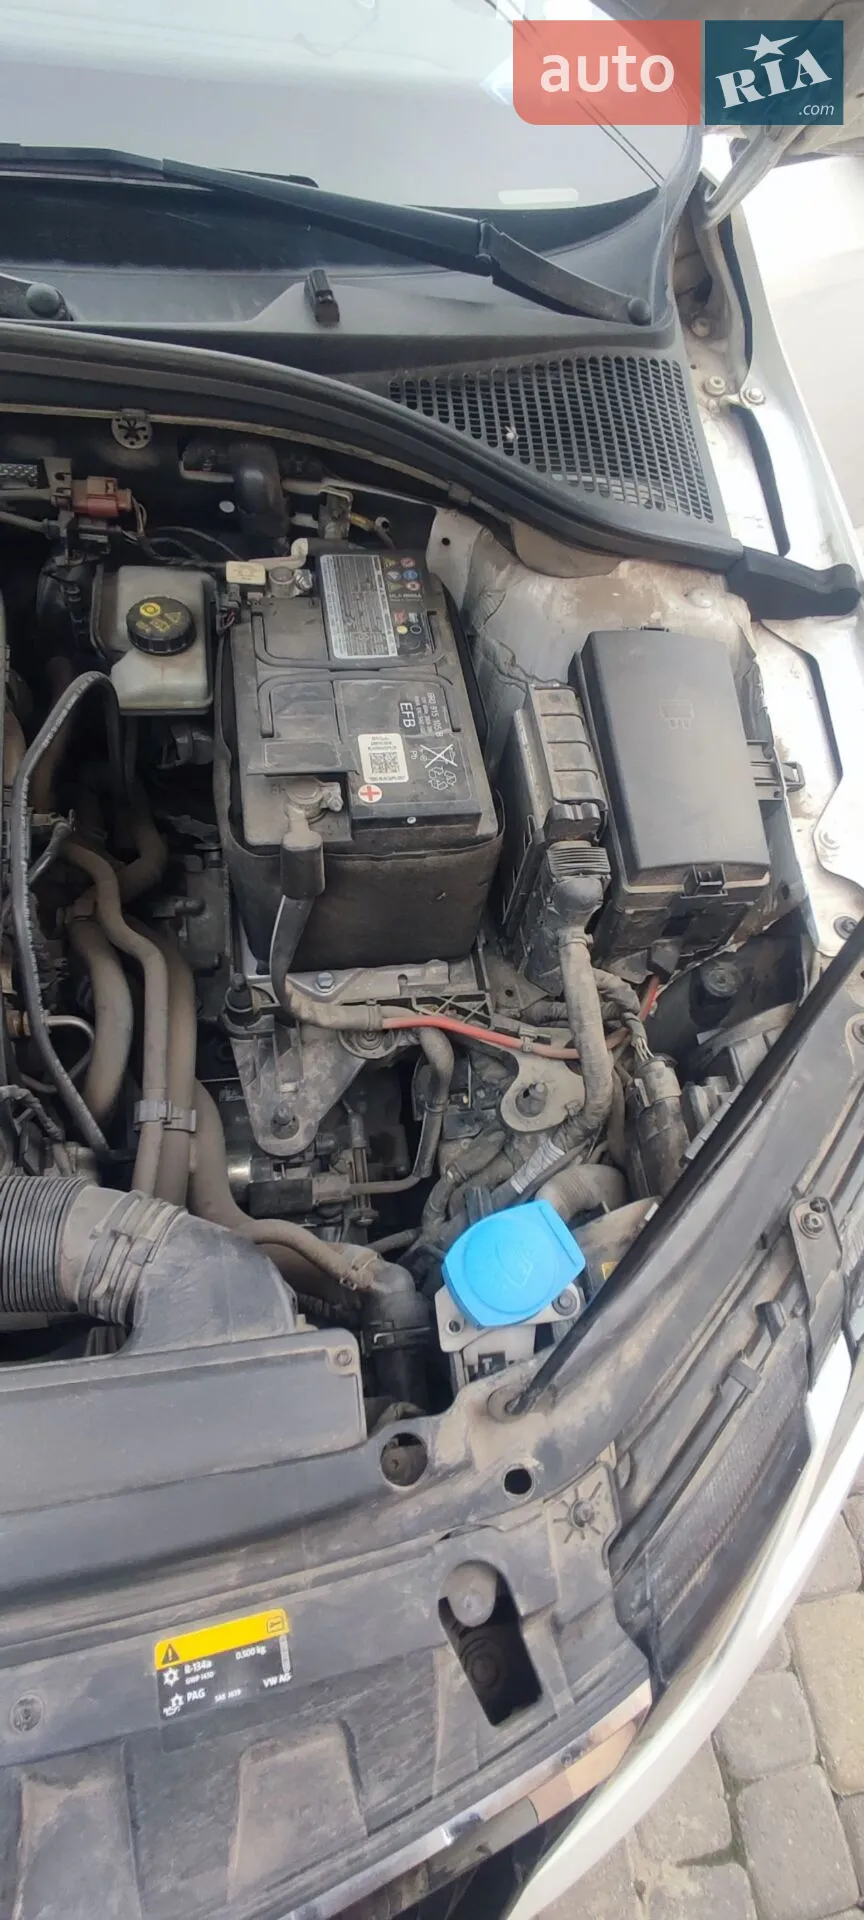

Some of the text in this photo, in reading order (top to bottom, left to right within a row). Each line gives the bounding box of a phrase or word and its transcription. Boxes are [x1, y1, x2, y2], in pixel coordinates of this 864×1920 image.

[400, 702, 416, 728] EFB
[184, 1660, 212, 1675] R-134a
[262, 1673, 292, 1688] VW AG
[187, 1688, 206, 1702] PAG
